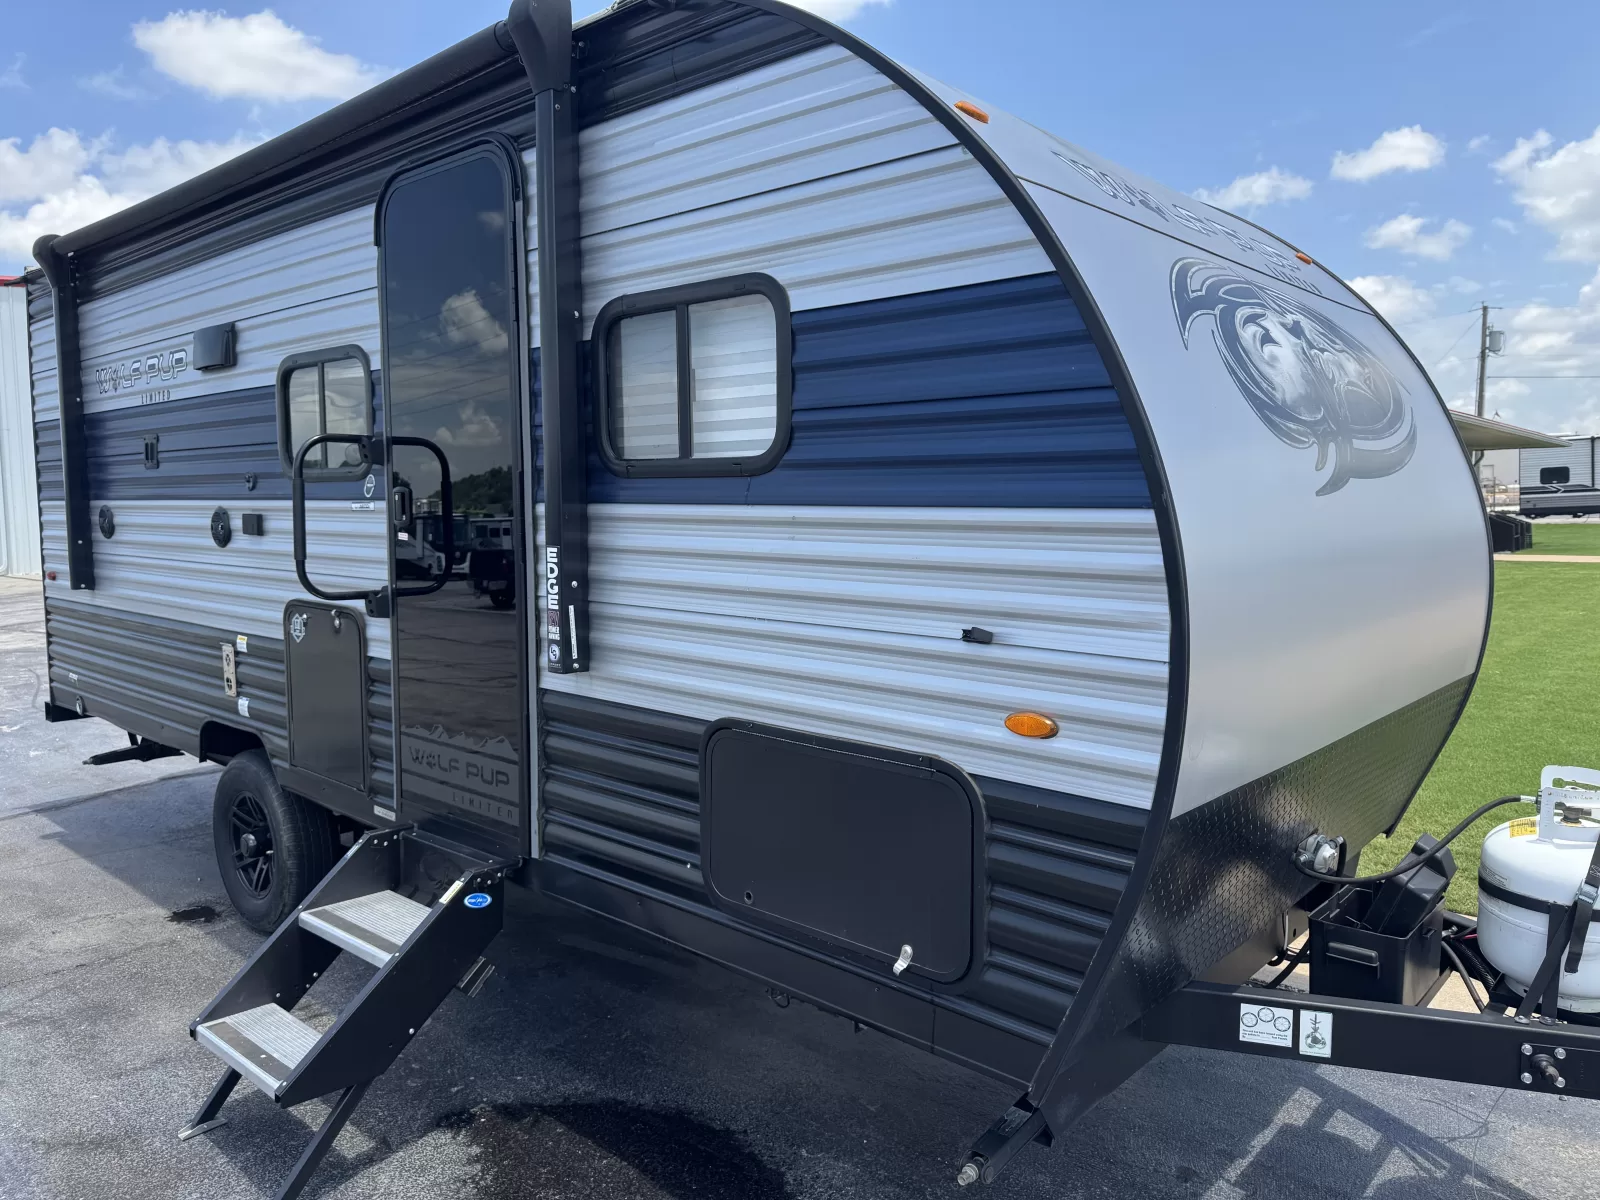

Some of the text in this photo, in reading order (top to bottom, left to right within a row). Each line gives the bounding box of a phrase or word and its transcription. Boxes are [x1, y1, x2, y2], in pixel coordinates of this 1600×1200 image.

[145, 348, 188, 384] PUP
[141, 390, 171, 405] LIMITED
[546, 547, 559, 610] EDGE
[466, 762, 510, 787] PUP
[452, 792, 513, 820] LIMITED
